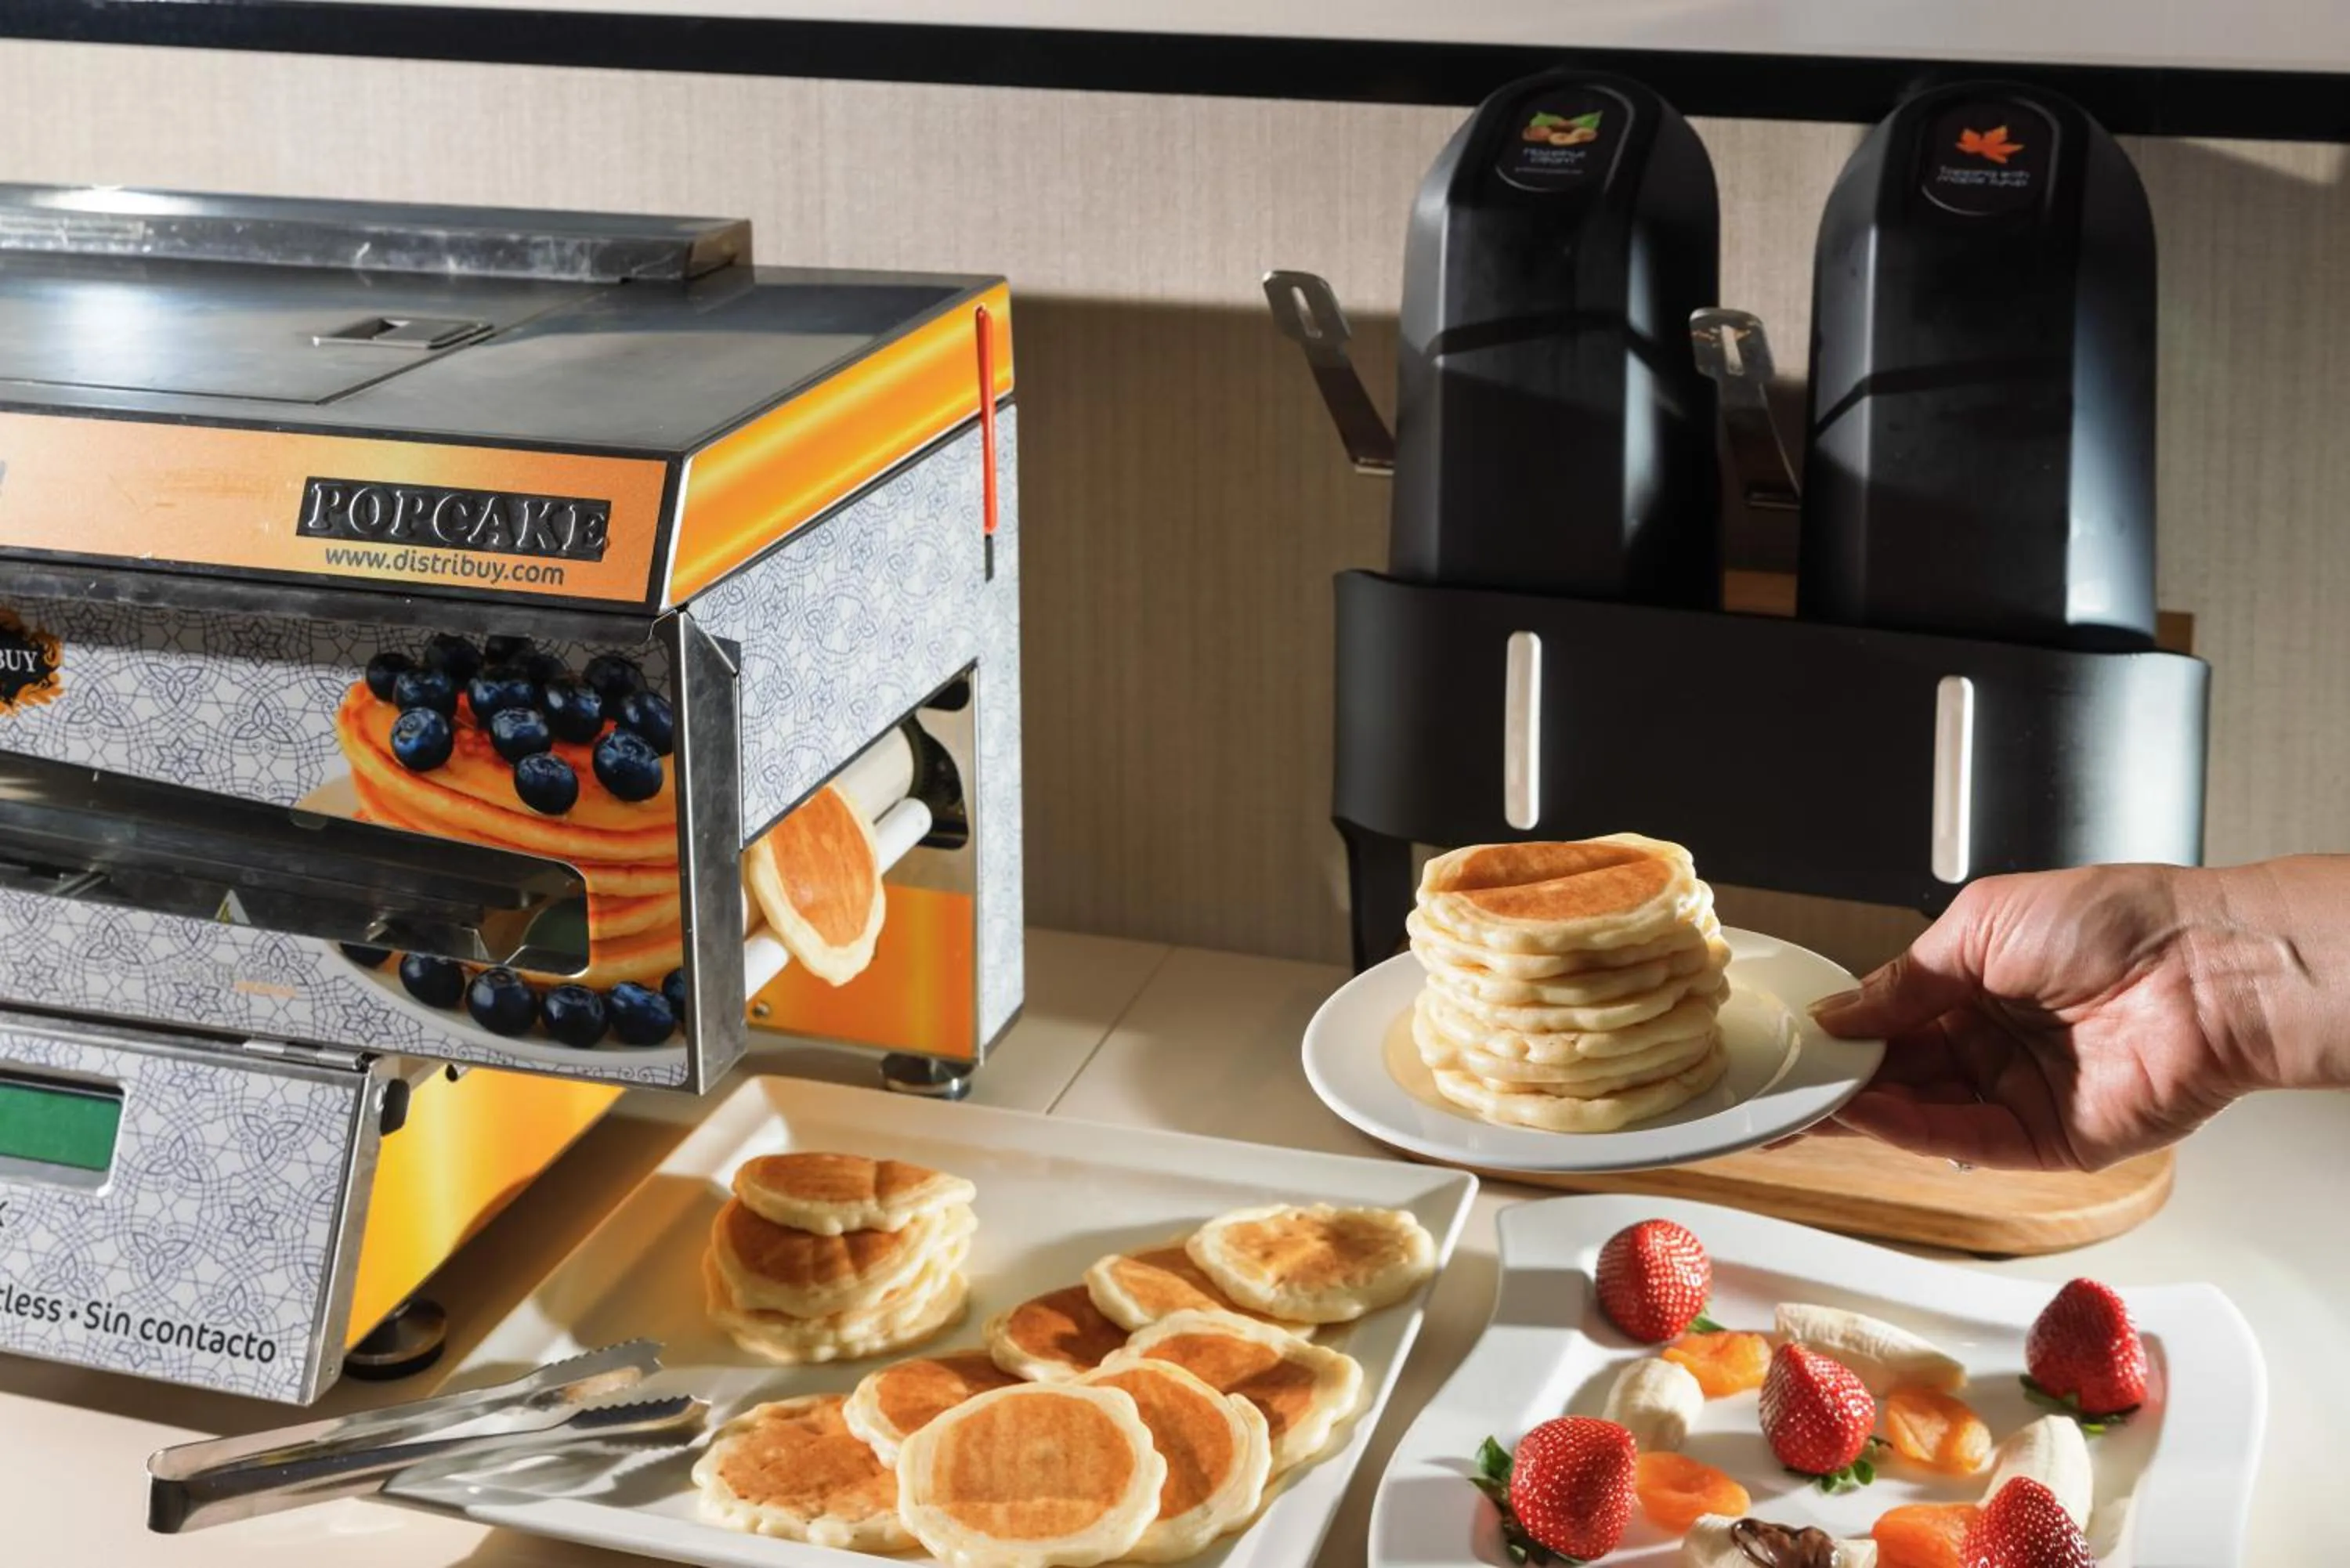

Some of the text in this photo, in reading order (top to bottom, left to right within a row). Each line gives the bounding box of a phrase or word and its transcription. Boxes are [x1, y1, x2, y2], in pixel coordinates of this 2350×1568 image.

[307, 482, 606, 555] POPCAKE
[324, 547, 565, 585] www.distribuy.com
[0, 1284, 277, 1364] less Sin contacto
